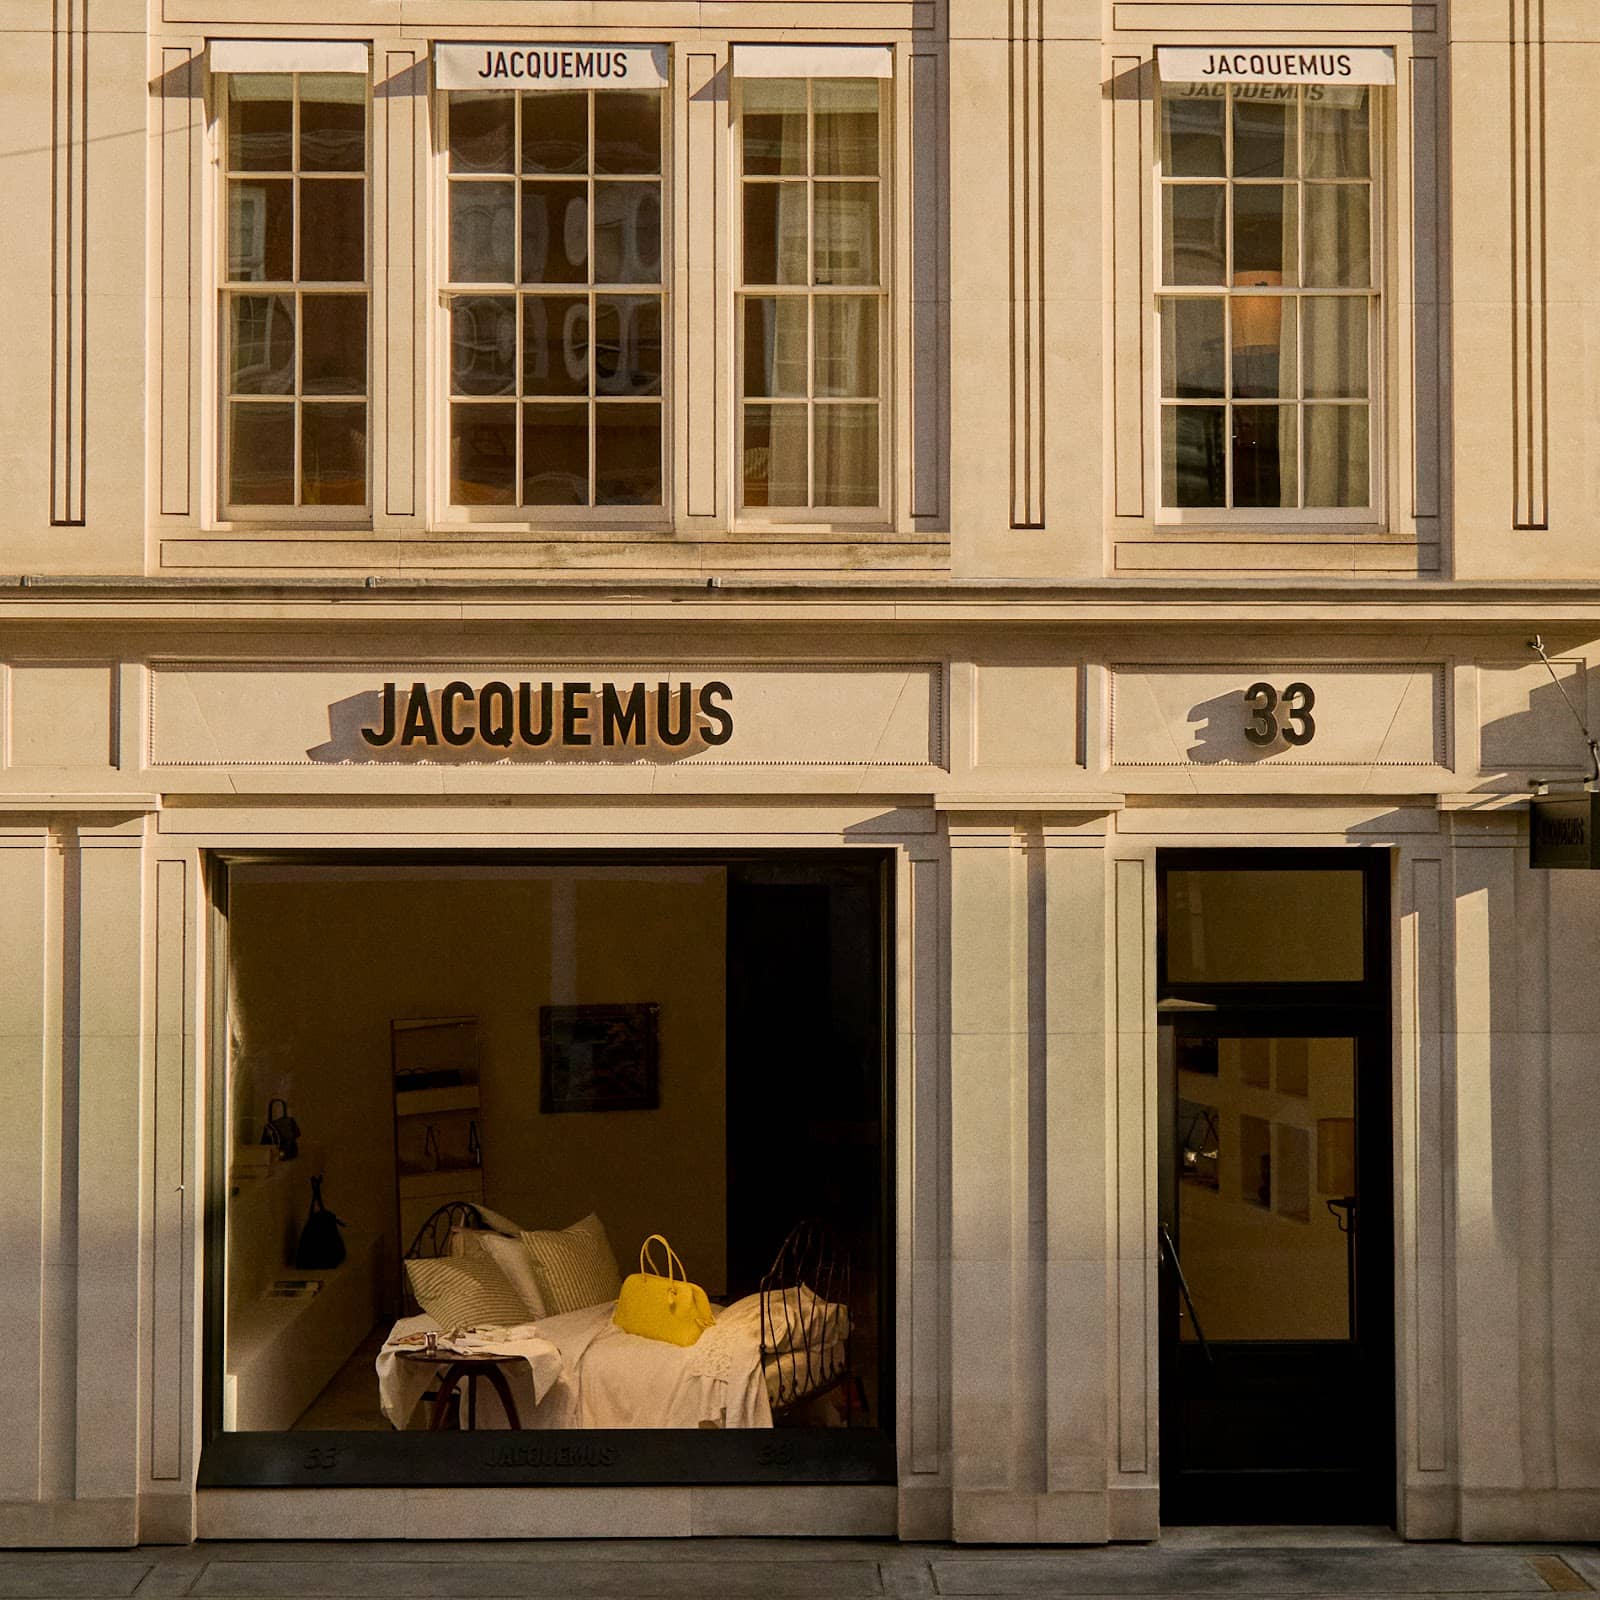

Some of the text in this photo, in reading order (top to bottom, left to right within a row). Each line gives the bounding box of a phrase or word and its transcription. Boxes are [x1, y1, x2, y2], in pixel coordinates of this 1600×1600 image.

[478, 51, 627, 78] JACQUEMUS
[1203, 55, 1351, 76] JACQUEMUS
[361, 681, 733, 748] JACQUEMUS
[1244, 682, 1316, 746] 33
